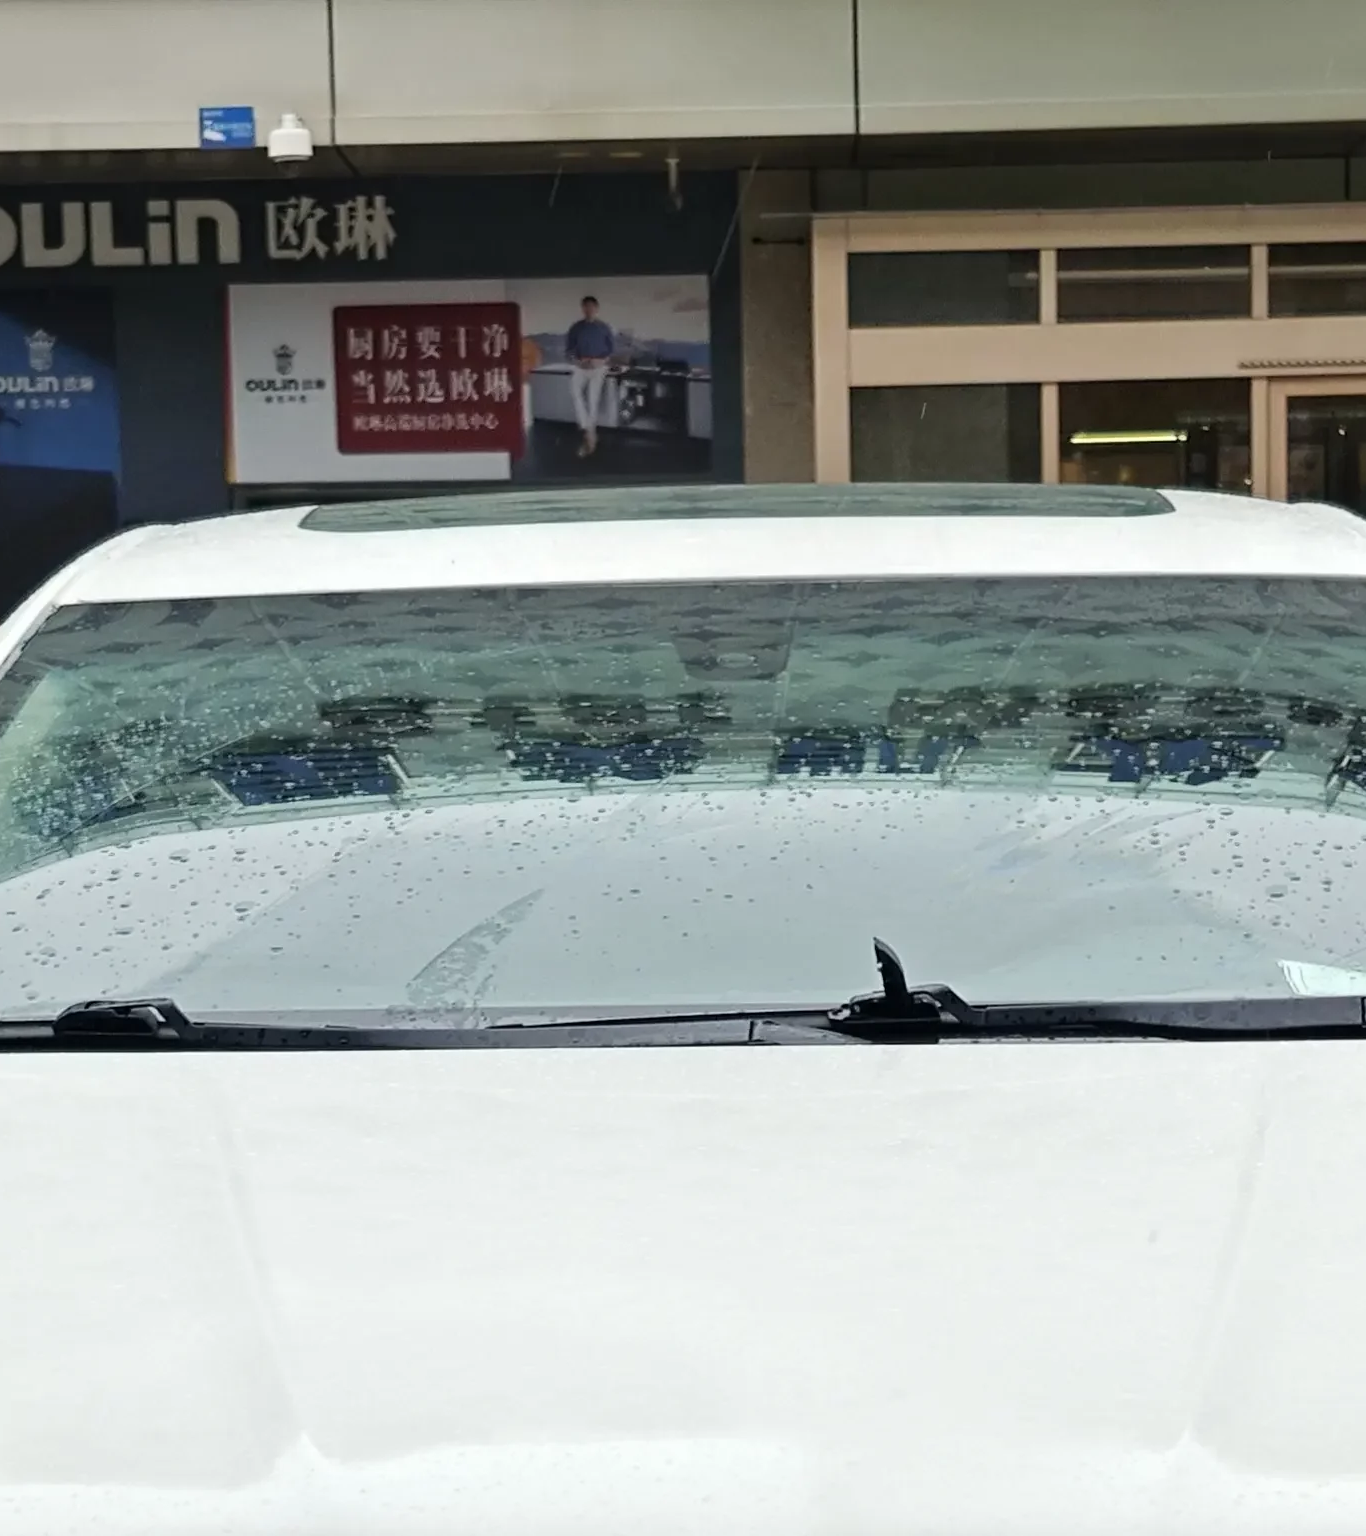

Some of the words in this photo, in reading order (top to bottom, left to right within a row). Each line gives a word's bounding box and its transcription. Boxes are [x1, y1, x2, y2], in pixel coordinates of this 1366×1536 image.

[265, 195, 397, 261] 欧琳
[346, 324, 509, 361] 厨房要干净
[351, 367, 513, 404] 当然选欧琳
